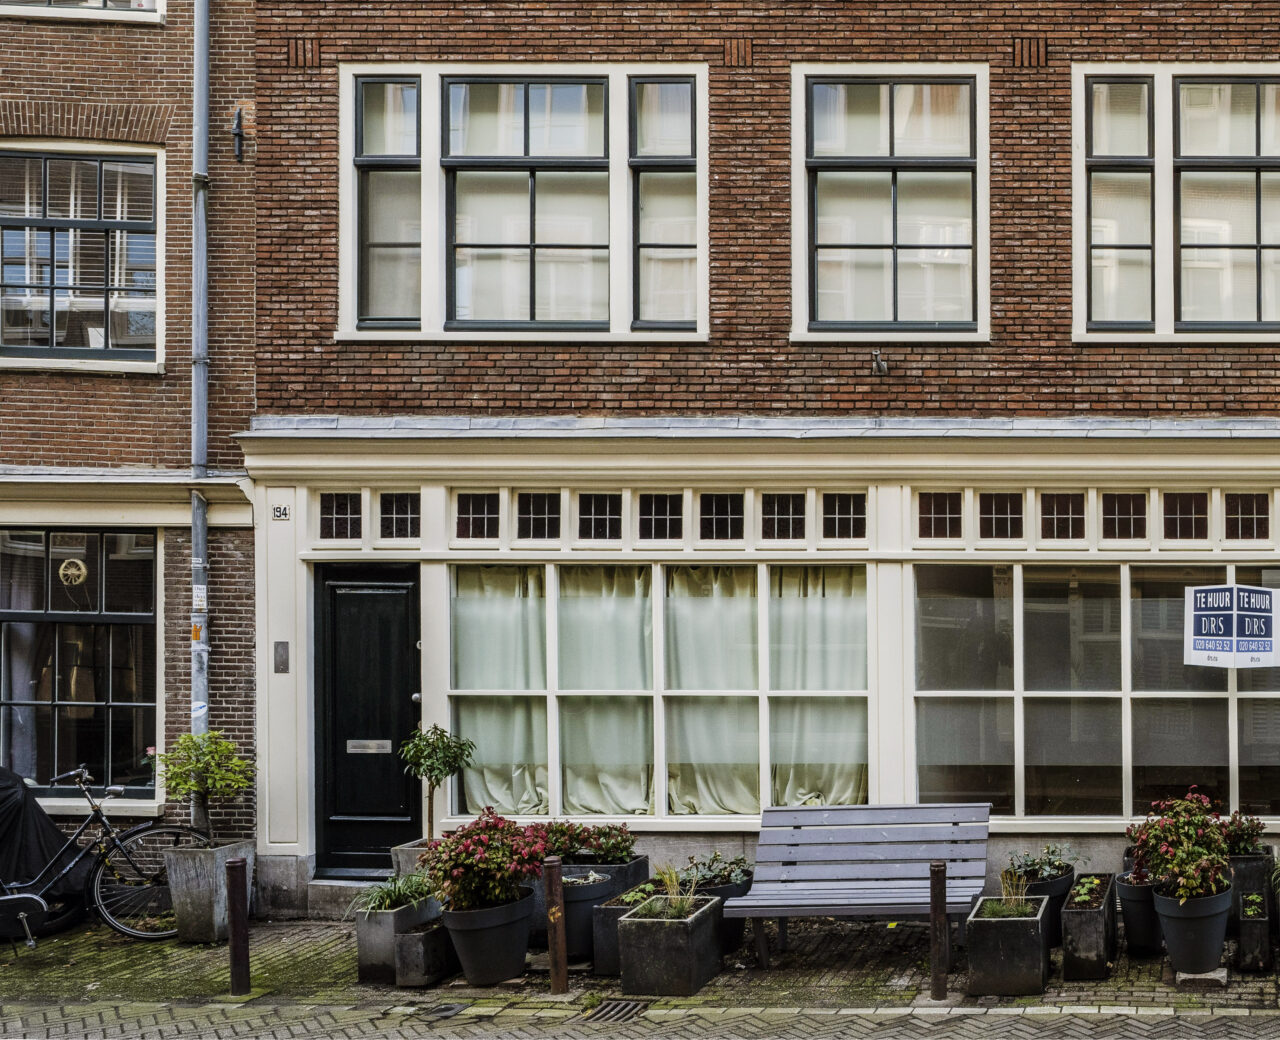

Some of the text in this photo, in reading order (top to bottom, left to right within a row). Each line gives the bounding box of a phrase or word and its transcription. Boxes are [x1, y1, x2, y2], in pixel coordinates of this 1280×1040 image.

[273, 506, 288, 518] 194
[1196, 591, 1230, 608] TE HUUR
[1239, 591, 1271, 610] TE HUUR
[1195, 639, 1231, 651] 020 640 52 52
[1238, 641, 1271, 651] 020 640 52 52
